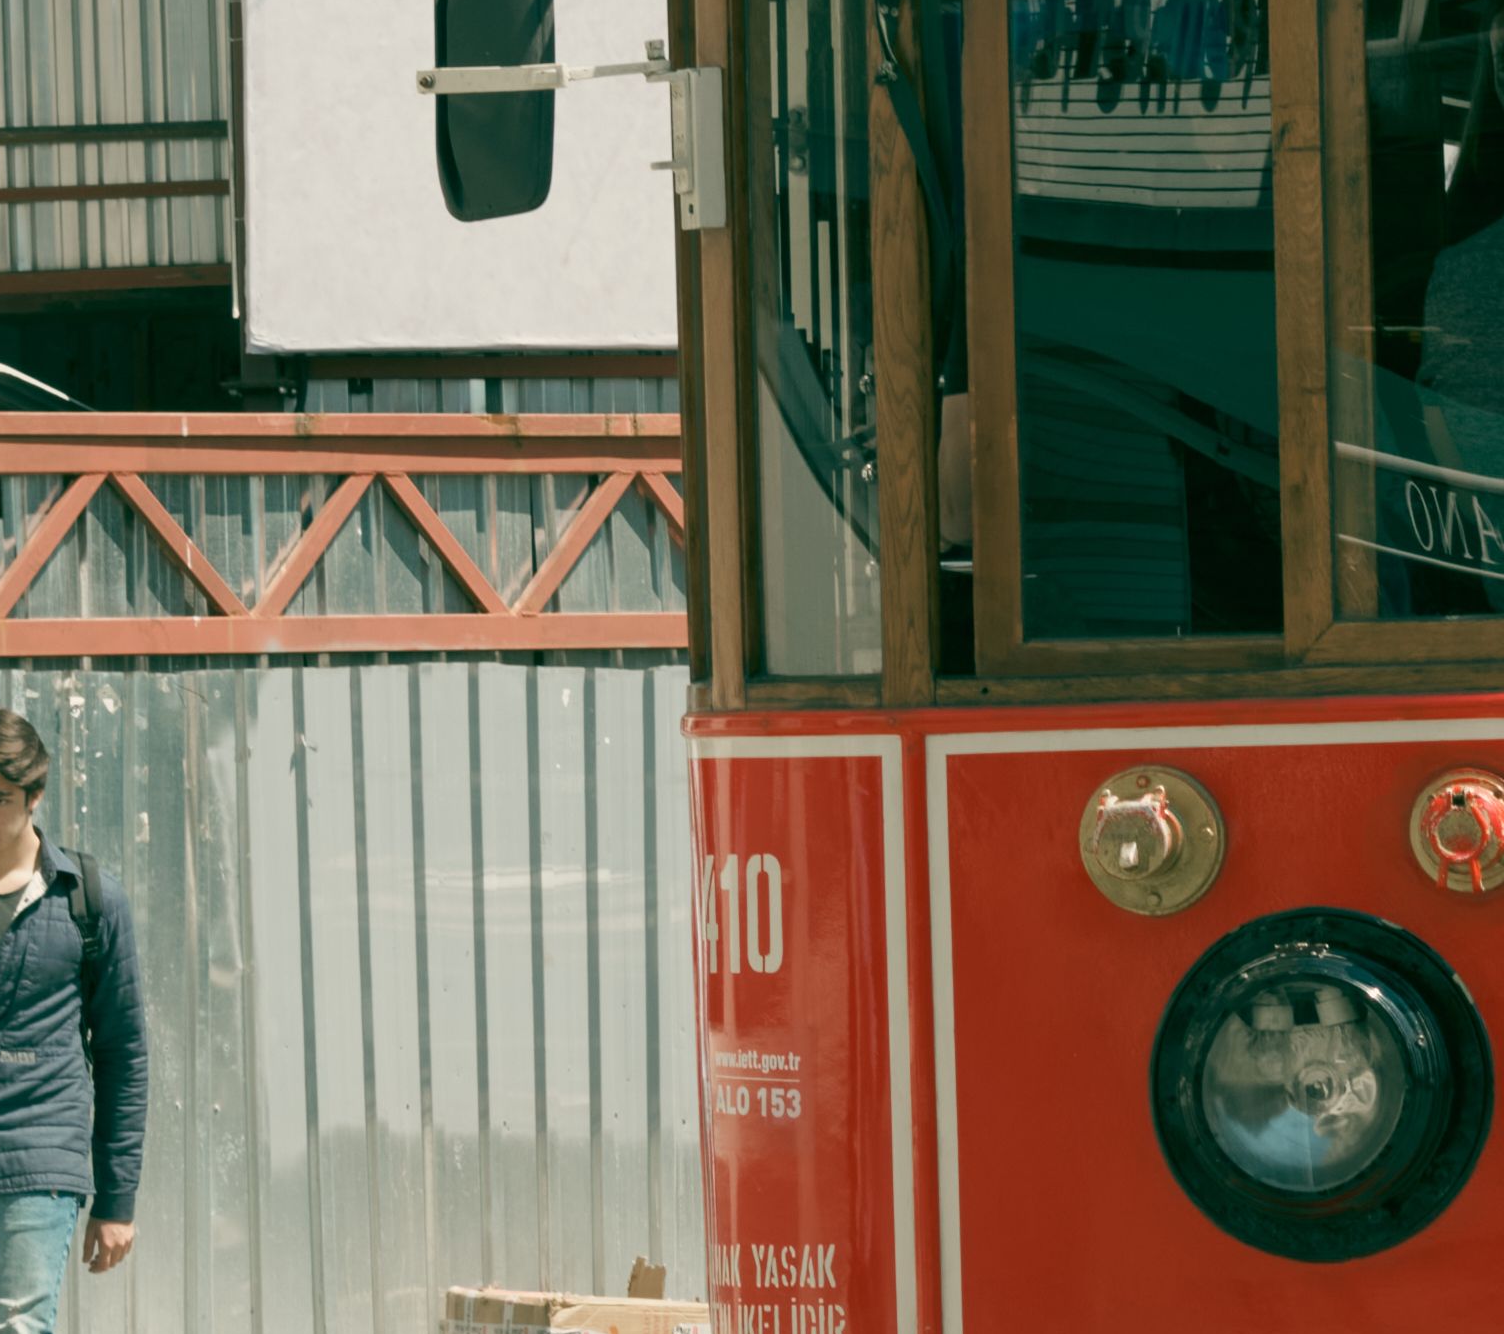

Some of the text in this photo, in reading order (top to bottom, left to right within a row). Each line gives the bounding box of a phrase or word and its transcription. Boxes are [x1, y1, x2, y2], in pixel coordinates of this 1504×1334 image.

[715, 1084, 802, 1119] ALO 153
[751, 1243, 836, 1289] YASAK
